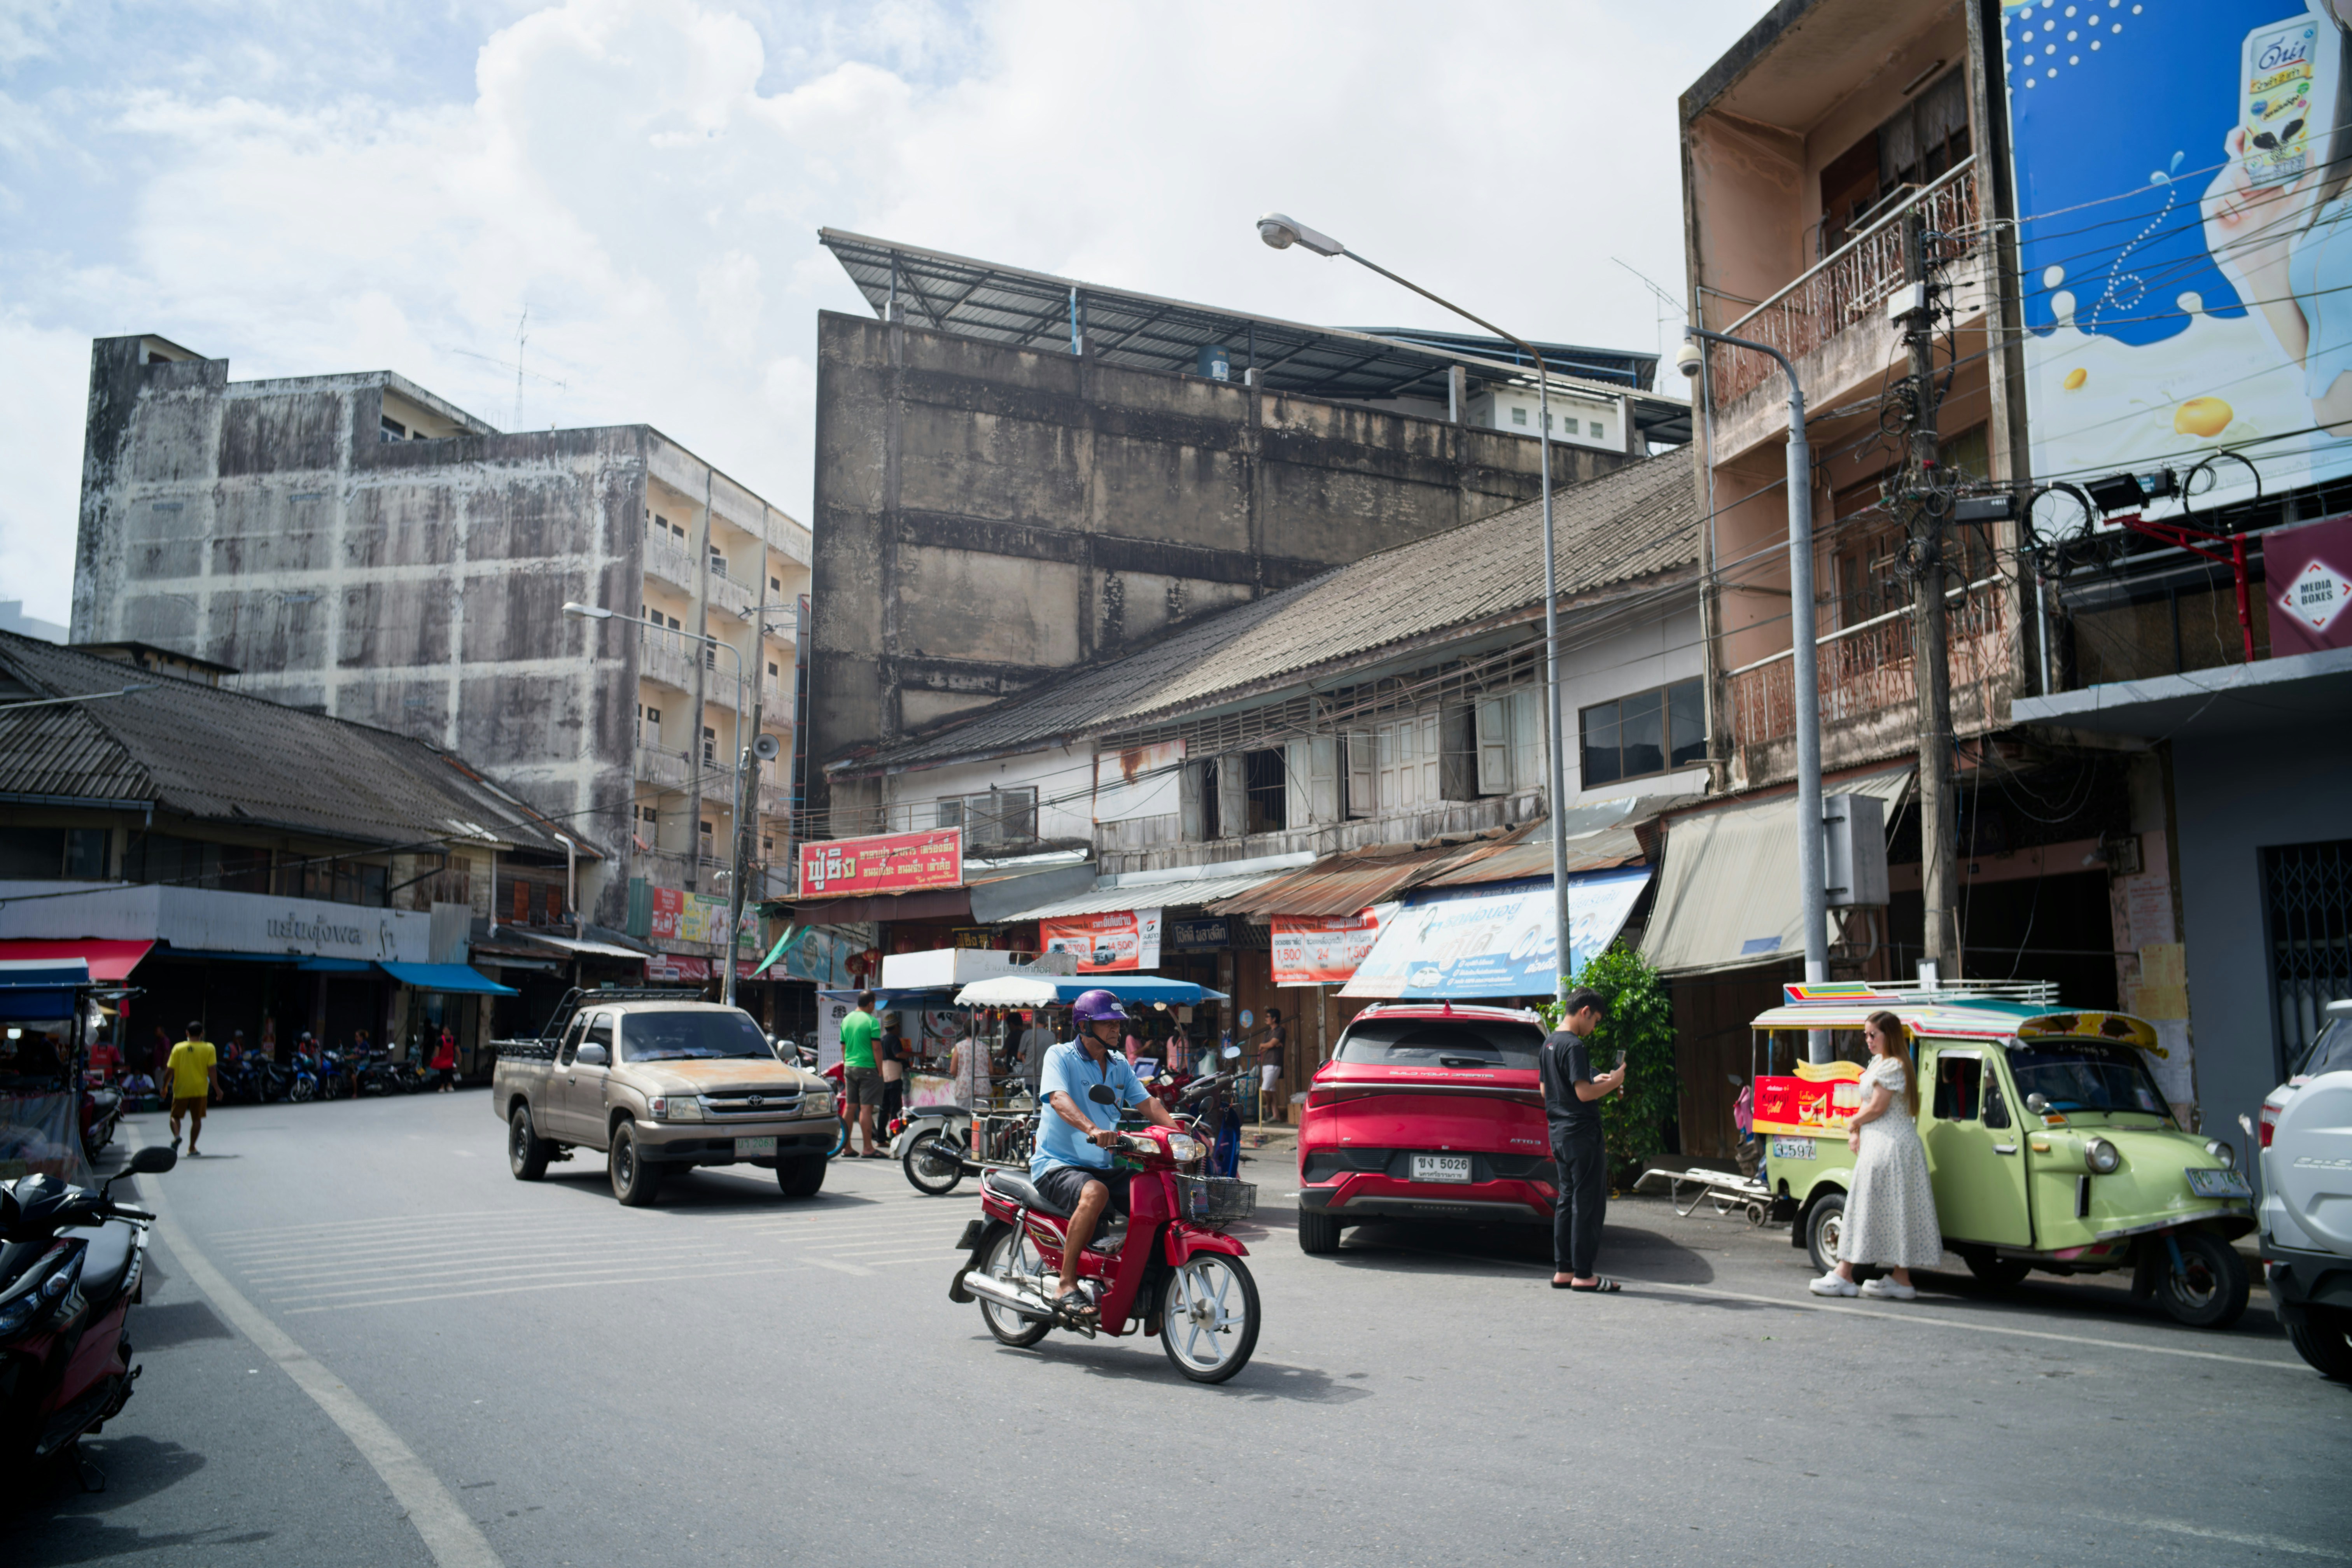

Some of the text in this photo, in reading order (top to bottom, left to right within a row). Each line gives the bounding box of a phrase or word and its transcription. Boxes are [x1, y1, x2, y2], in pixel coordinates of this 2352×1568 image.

[2300, 579, 2332, 593] MEDIA
[2301, 590, 2333, 606] BOXES
[1277, 948, 1301, 963] 1,500
[1317, 947, 1329, 960] 24
[752, 1138, 774, 1148] 2063
[1788, 1144, 1813, 1158] 597
[1440, 1158, 1467, 1170] 5026
